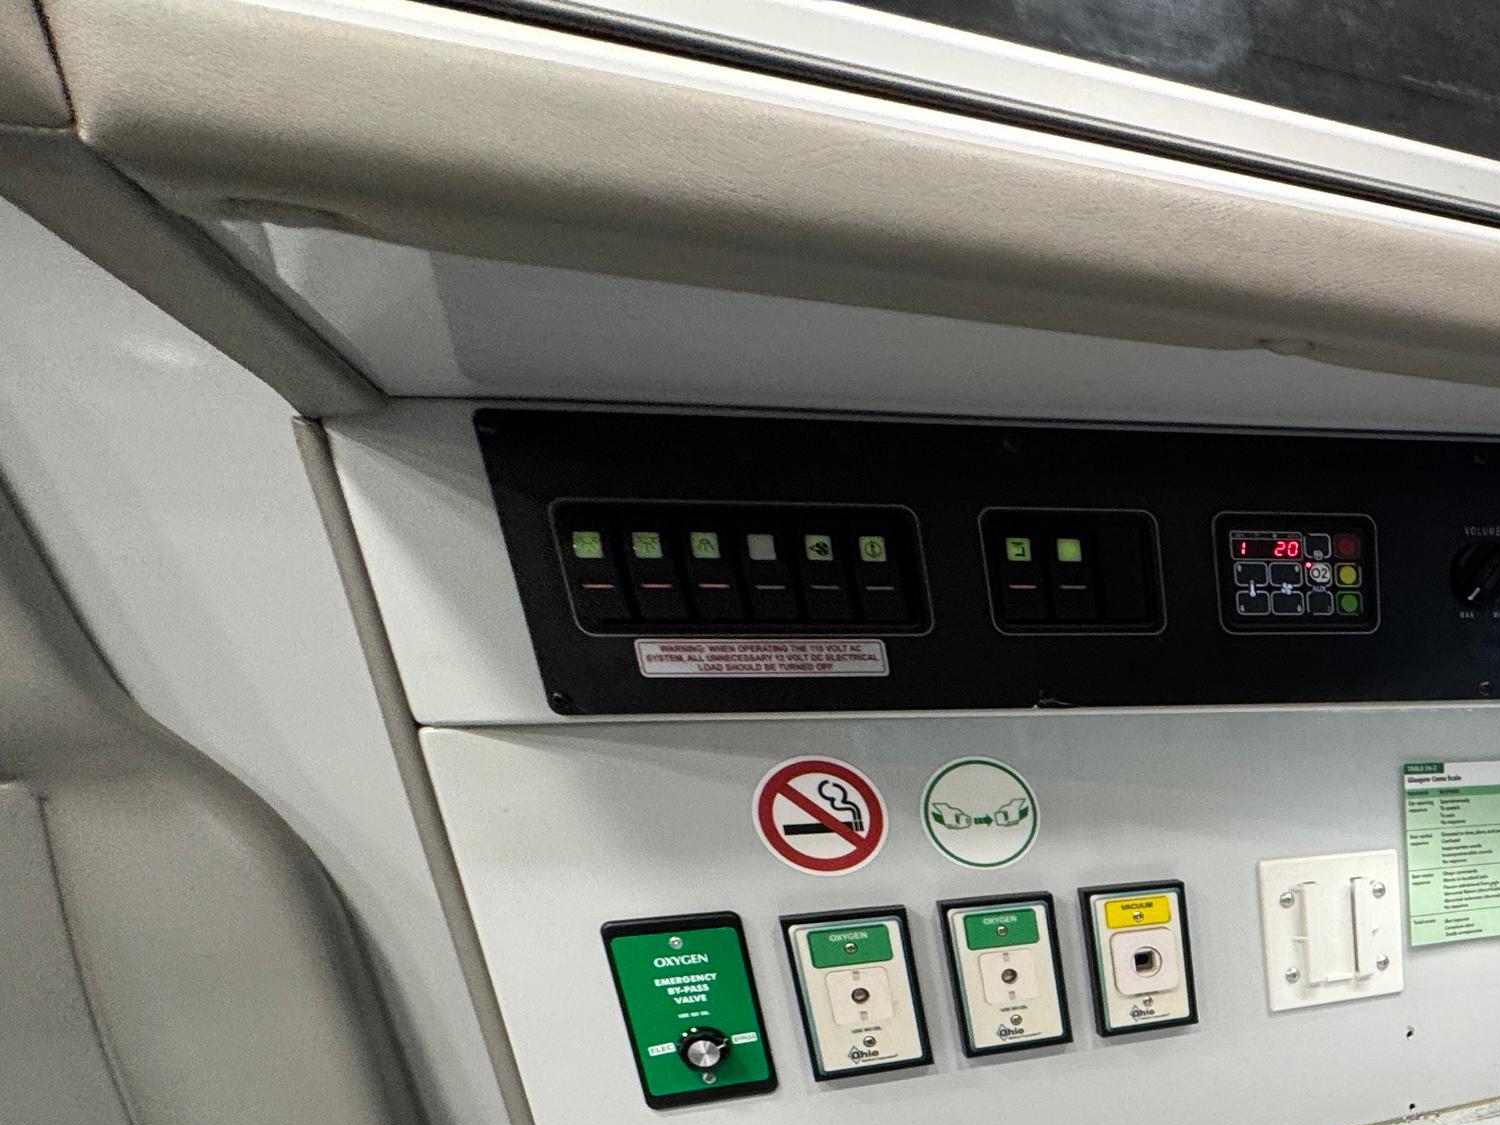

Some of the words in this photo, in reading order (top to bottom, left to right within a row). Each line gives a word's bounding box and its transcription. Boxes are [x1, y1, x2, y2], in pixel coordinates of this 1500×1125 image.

[1464, 526, 1500, 536] VOLUME
[1241, 541, 1246, 555] 1
[1273, 541, 1299, 557] 20
[1311, 567, 1328, 579] O2
[737, 645, 788, 653] OPERATING
[687, 654, 705, 662] ALL
[705, 654, 773, 662] UNNECESSARY
[786, 654, 808, 662] VOLT
[825, 654, 878, 662] ELECTRICAL
[697, 663, 724, 671] LOAD
[725, 663, 762, 671] SHOULD
[764, 663, 777, 671] BE
[778, 663, 815, 671] TURNED
[1407, 776, 1430, 785] Glasgow
[1431, 775, 1447, 783] Coma
[1447, 773, 1462, 782] Scale
[1121, 901, 1154, 911] VACUUM
[982, 914, 1018, 926] OXYGEN
[829, 930, 869, 942] OXYGEN
[653, 953, 709, 968] OXYGEN
[653, 972, 717, 987] EMERGENCY
[666, 983, 710, 995] BY-PASS
[673, 994, 708, 1005] VALVE
[999, 1027, 1025, 1037] Ohio
[650, 1043, 674, 1054] ELEC
[851, 1049, 880, 1060] Ohio
